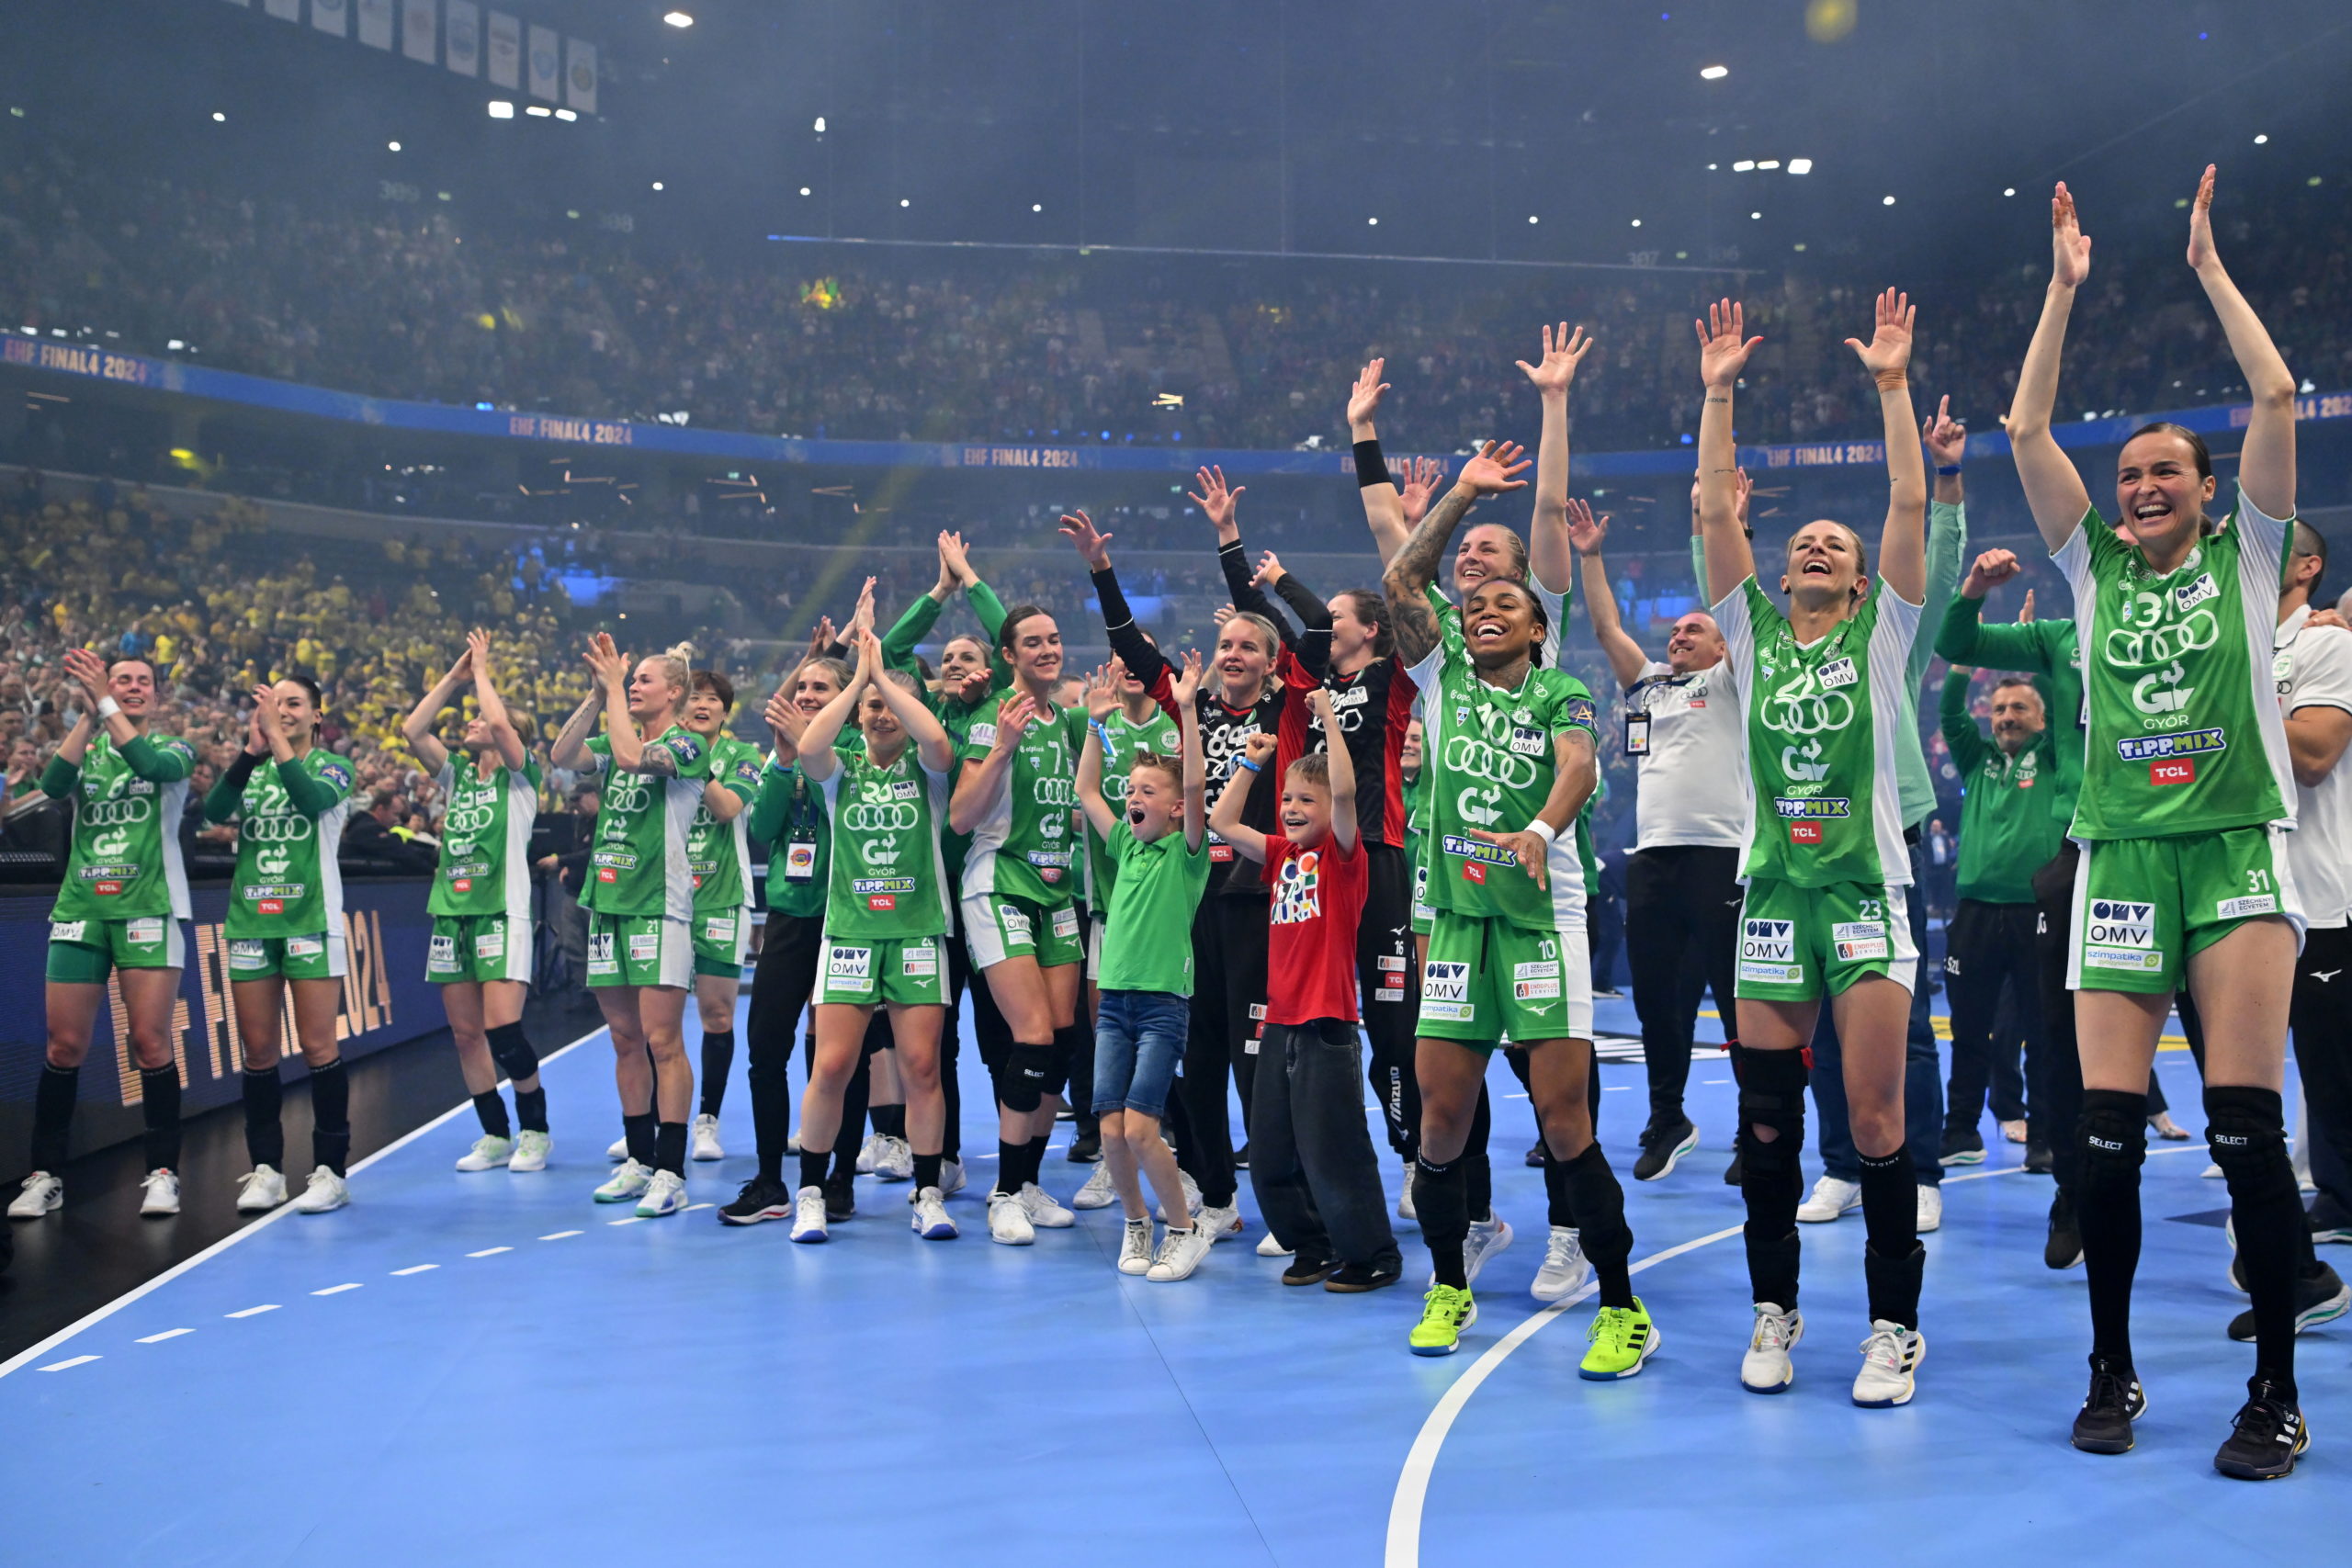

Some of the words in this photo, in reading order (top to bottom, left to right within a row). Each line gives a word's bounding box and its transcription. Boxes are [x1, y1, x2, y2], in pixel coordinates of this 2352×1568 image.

[5, 338, 35, 363] EHF
[40, 344, 99, 375] FINAL4
[103, 355, 146, 382] 2024
[509, 416, 535, 435] EHF
[540, 419, 590, 442] FINAL4
[595, 424, 632, 445] 2024
[965, 448, 988, 466] EHF
[992, 448, 1038, 467] FINAL4
[1043, 449, 1079, 468] 2024
[1767, 448, 1791, 467] EHF
[1795, 446, 1843, 466] FINAL4
[1847, 445, 1883, 463] 2024
[2181, 586, 2213, 610] OMV
[2135, 588, 2174, 627] 31
[1824, 671, 1855, 688] OMV
[1343, 696, 1364, 705] OMV
[1476, 702, 1510, 747] 10
[2143, 715, 2189, 730] GYŐR
[1511, 741, 1542, 753] OMV
[2155, 766, 2188, 778] TCL
[107, 773, 129, 800] 6
[861, 781, 893, 804] 20
[1786, 784, 1823, 795] GYŐR
[1792, 828, 1816, 837] TCL
[96, 857, 124, 865] GYŐR
[868, 866, 896, 876] GYŐR
[259, 875, 286, 885] GYŐR
[2246, 868, 2270, 893] 31
[872, 898, 891, 907] TCL
[1859, 900, 1882, 920] 23
[492, 920, 504, 933] 15
[646, 919, 659, 933] 21
[2090, 925, 2148, 945] OMV
[1395, 941, 1404, 955] 16
[1538, 939, 1556, 960] 10
[1744, 942, 1789, 958] OMV
[2087, 951, 2143, 962] szimpatika
[831, 963, 865, 975] OMV
[1742, 965, 1785, 976] szimpatika
[1424, 982, 1464, 998] OMV
[1023, 1068, 1045, 1077] SELECT
[2088, 1135, 2123, 1151] SELECT
[2214, 1134, 2248, 1145] SELECT
